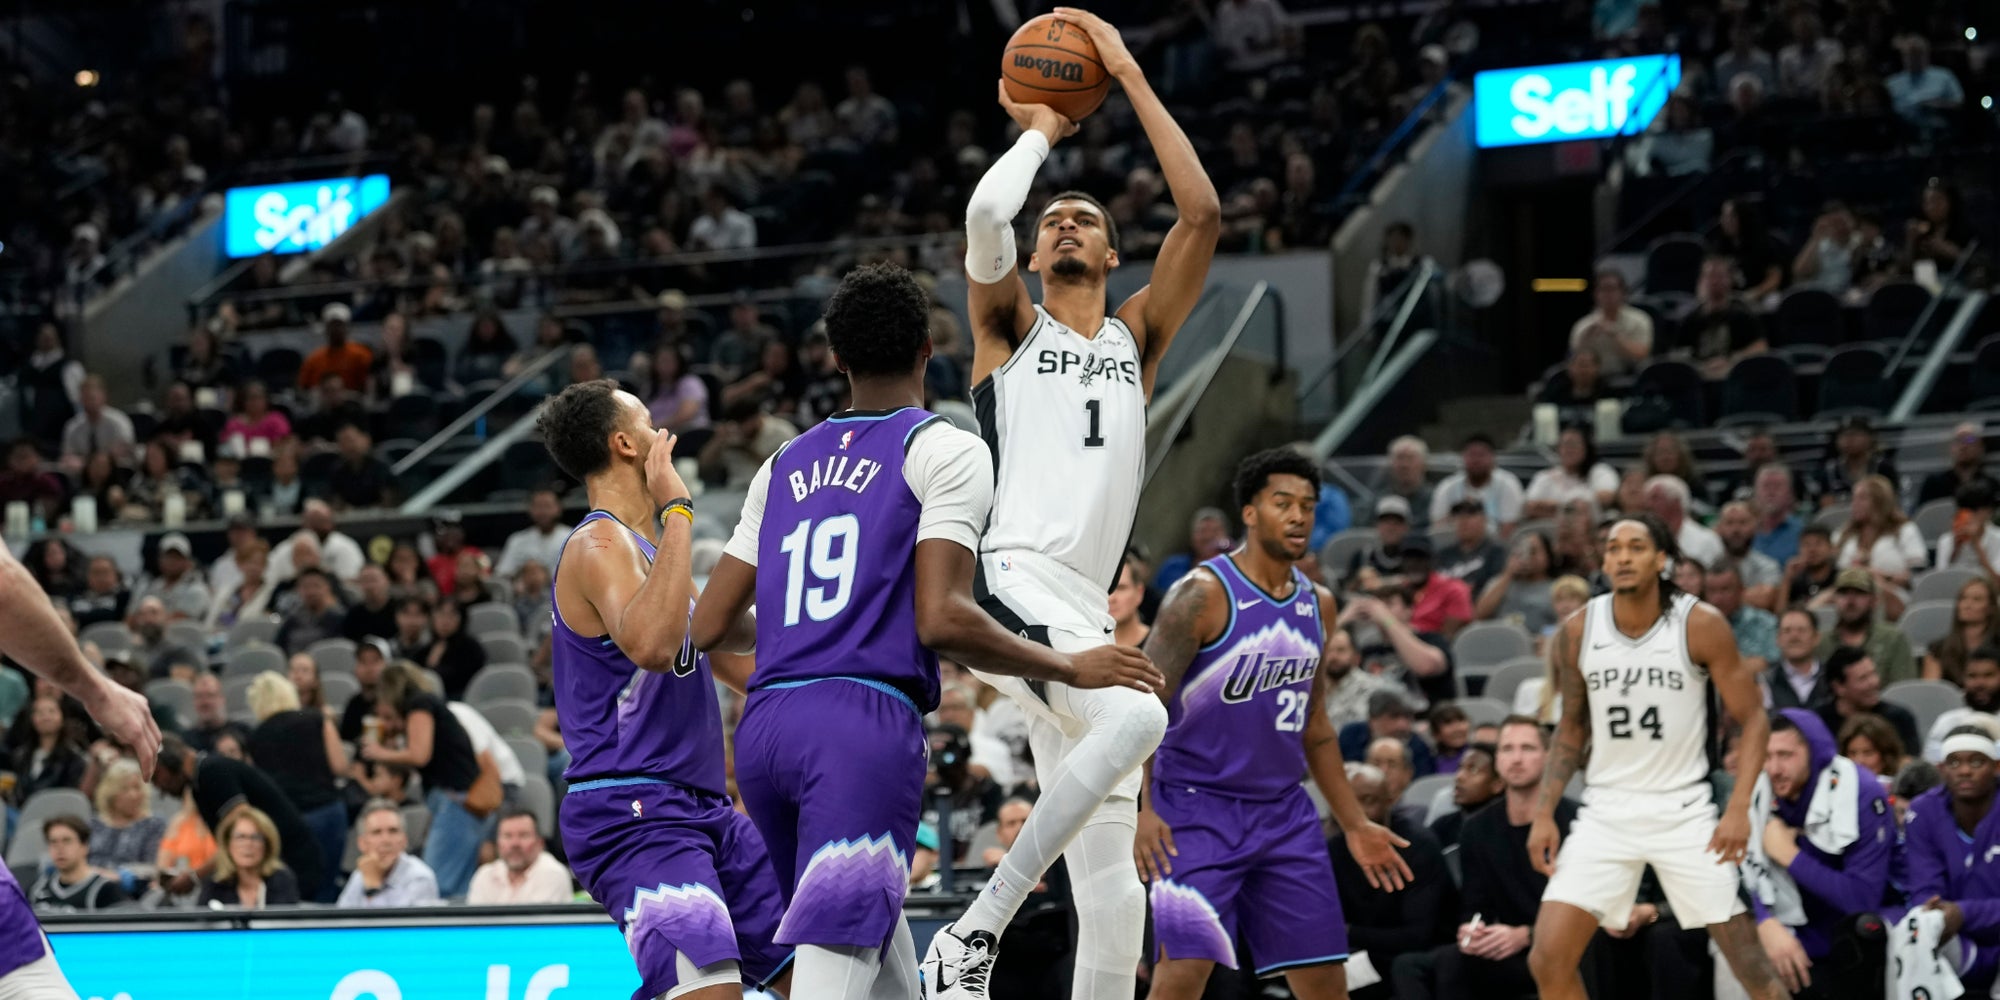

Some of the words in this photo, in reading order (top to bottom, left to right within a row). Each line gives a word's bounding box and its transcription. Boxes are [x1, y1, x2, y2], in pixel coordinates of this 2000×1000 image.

[1013, 53, 1084, 83] Wilson
[1509, 63, 1637, 138] Self
[1037, 350, 1135, 387] SPURS
[1083, 398, 1106, 449] 1
[789, 455, 882, 503] BAILEY
[780, 513, 860, 627] 19
[1587, 667, 1683, 696] SPURS
[1608, 706, 1664, 739] 24
